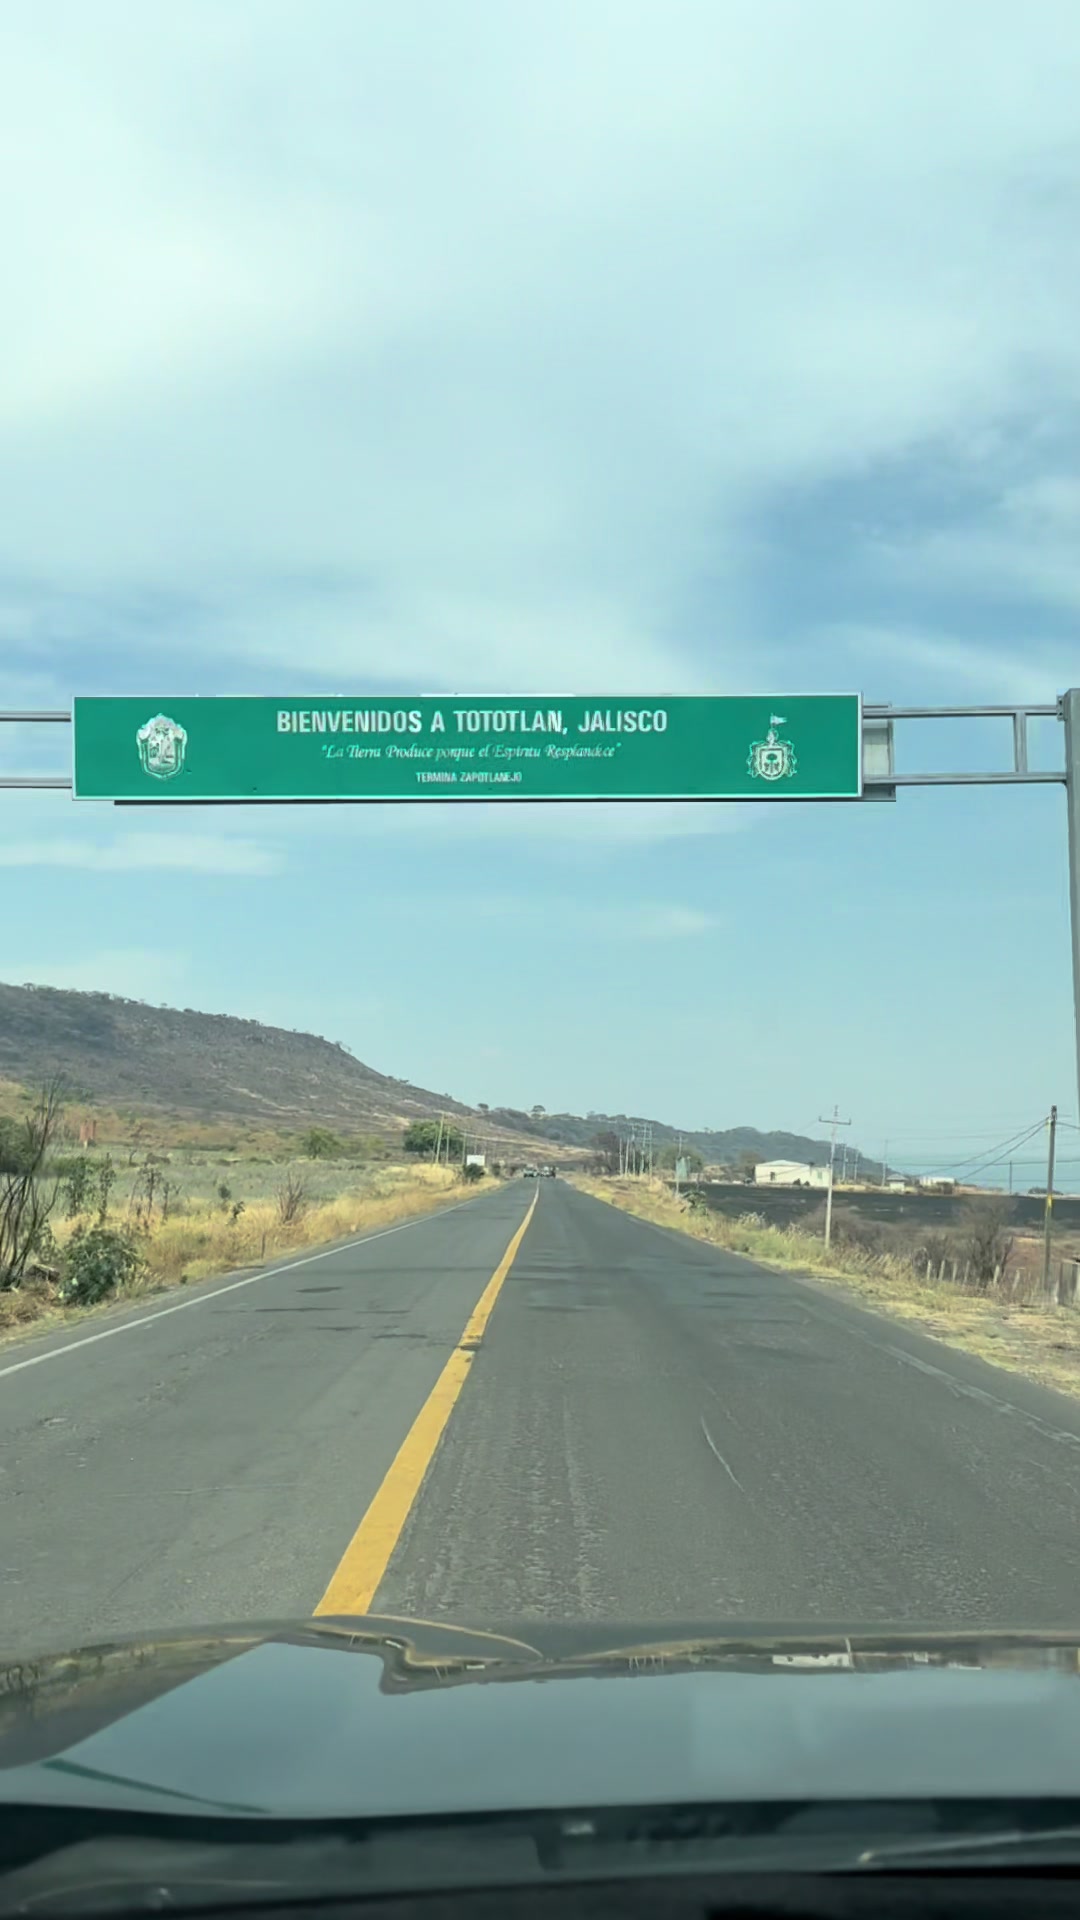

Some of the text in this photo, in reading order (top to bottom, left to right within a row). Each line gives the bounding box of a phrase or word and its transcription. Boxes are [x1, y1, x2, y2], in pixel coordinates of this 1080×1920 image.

[277, 710, 667, 735] BIENVENIDOS A TOTOTLAN, JALISCO
[346, 745, 381, 758] Tierra
[385, 744, 433, 759] Produce
[435, 747, 475, 761] porque
[478, 744, 490, 758] el
[416, 771, 522, 783] TERMINA ZAPOTLANEJO
